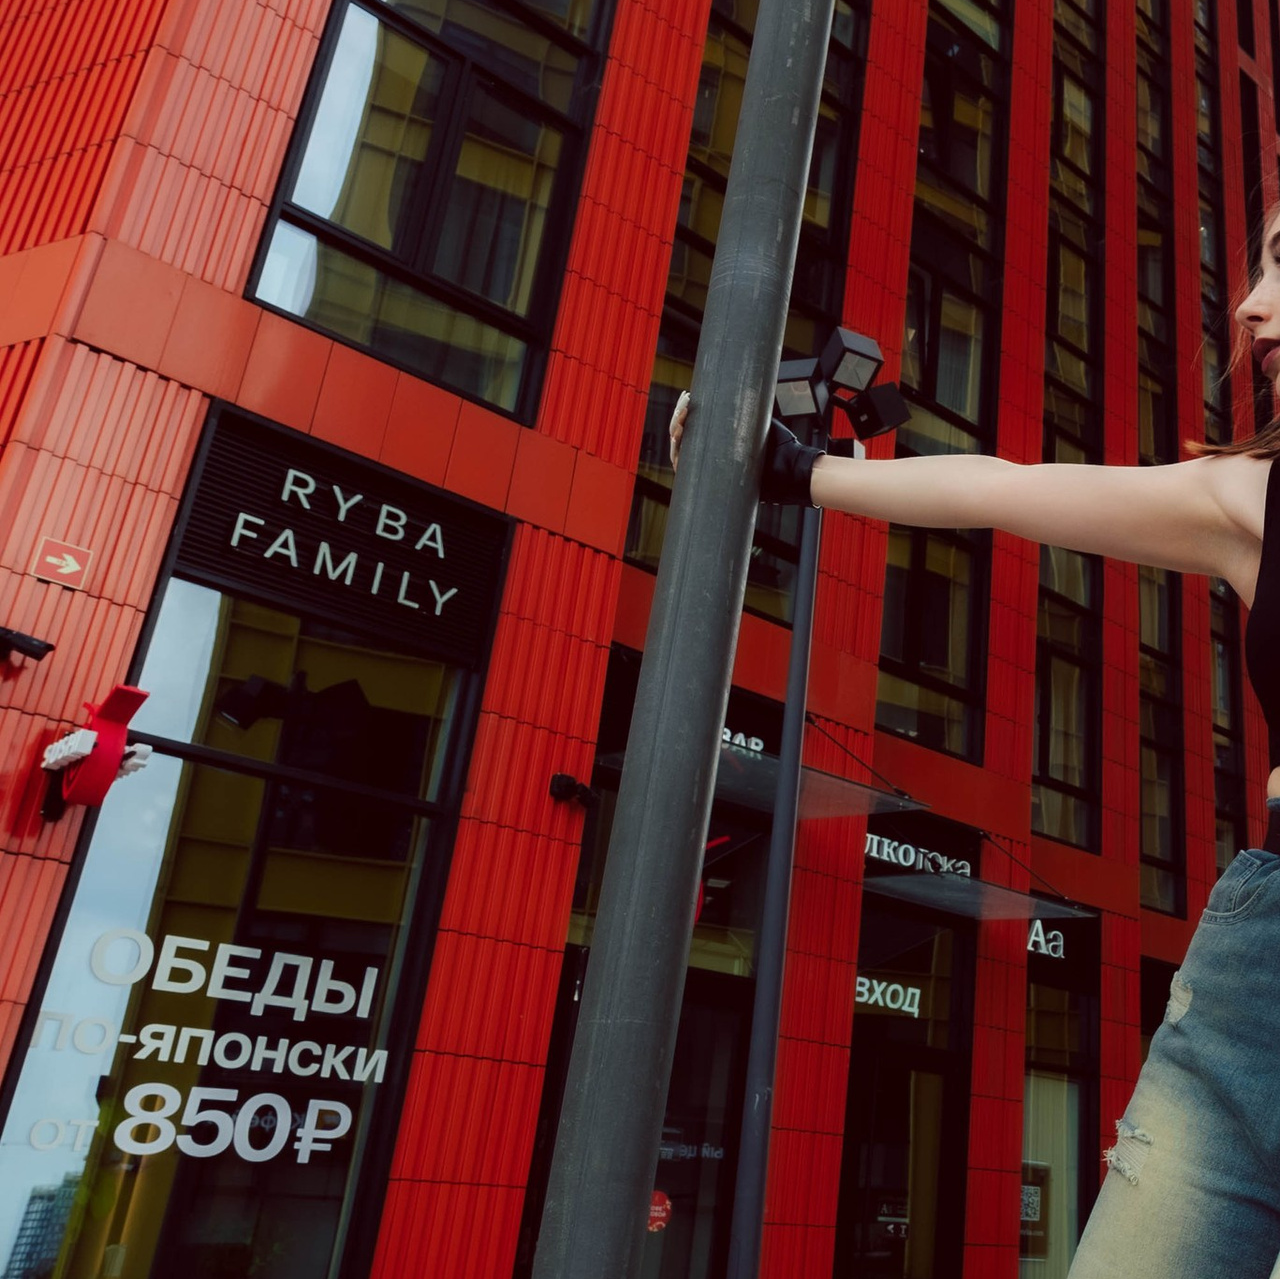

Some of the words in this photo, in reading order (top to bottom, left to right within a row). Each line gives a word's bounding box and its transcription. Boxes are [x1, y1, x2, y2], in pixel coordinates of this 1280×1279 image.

[281, 468, 445, 559] RYBA
[230, 512, 459, 616] FAMILY
[91, 928, 379, 1021] ОБЕДЫ
[855, 976, 921, 1018] ВХОД
[29, 1118, 99, 1152] от
[113, 1083, 353, 1164] 850₽
